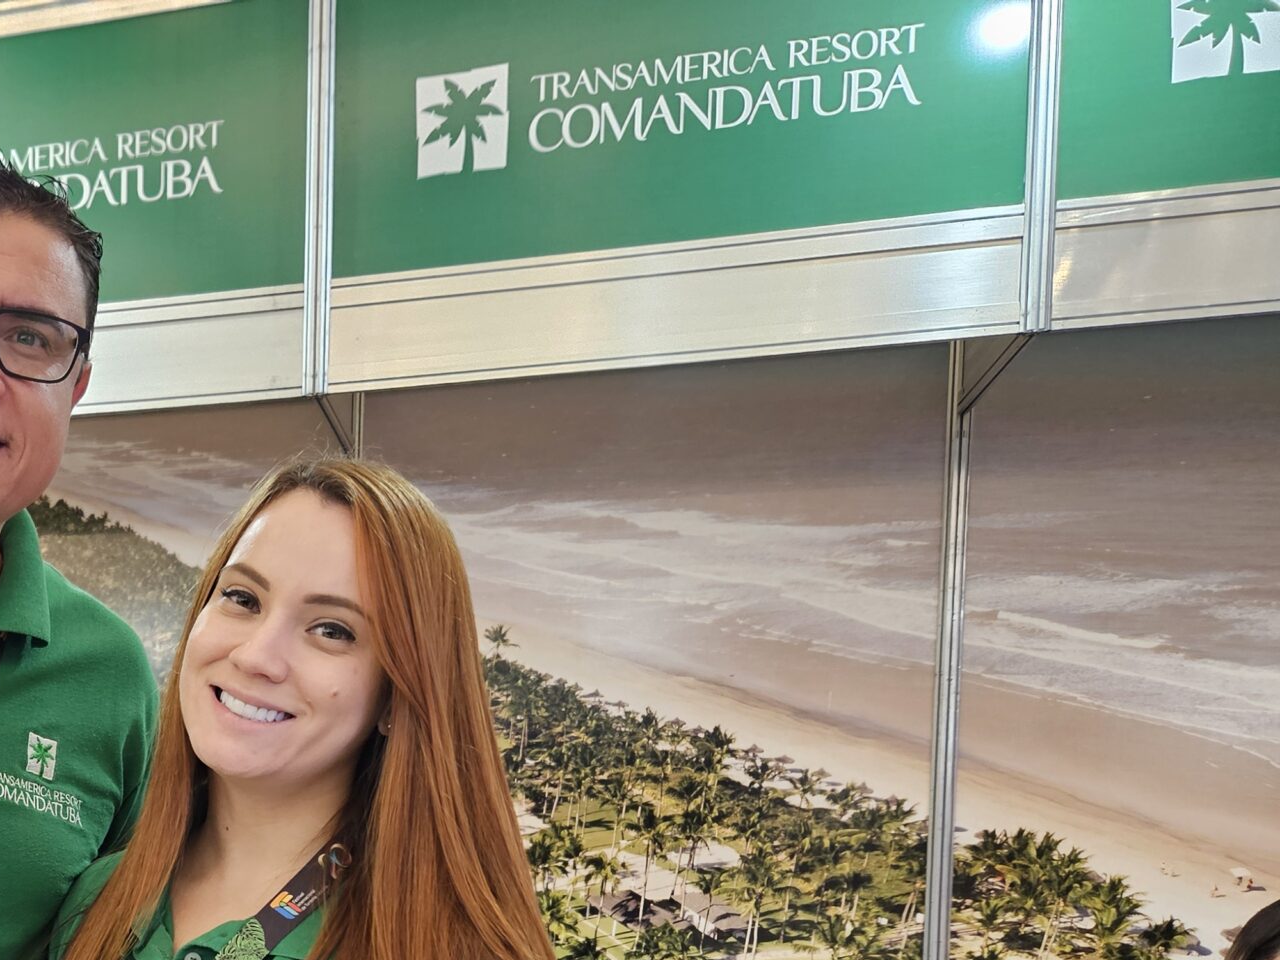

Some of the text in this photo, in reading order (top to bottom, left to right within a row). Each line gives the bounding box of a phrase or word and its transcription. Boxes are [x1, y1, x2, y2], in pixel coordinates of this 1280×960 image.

[530, 23, 925, 104] TRANSAMERICA RESORT
[528, 63, 923, 154] COMANDATUBA
[117, 120, 225, 160] RESORT
[54, 790, 83, 809] RESORT
